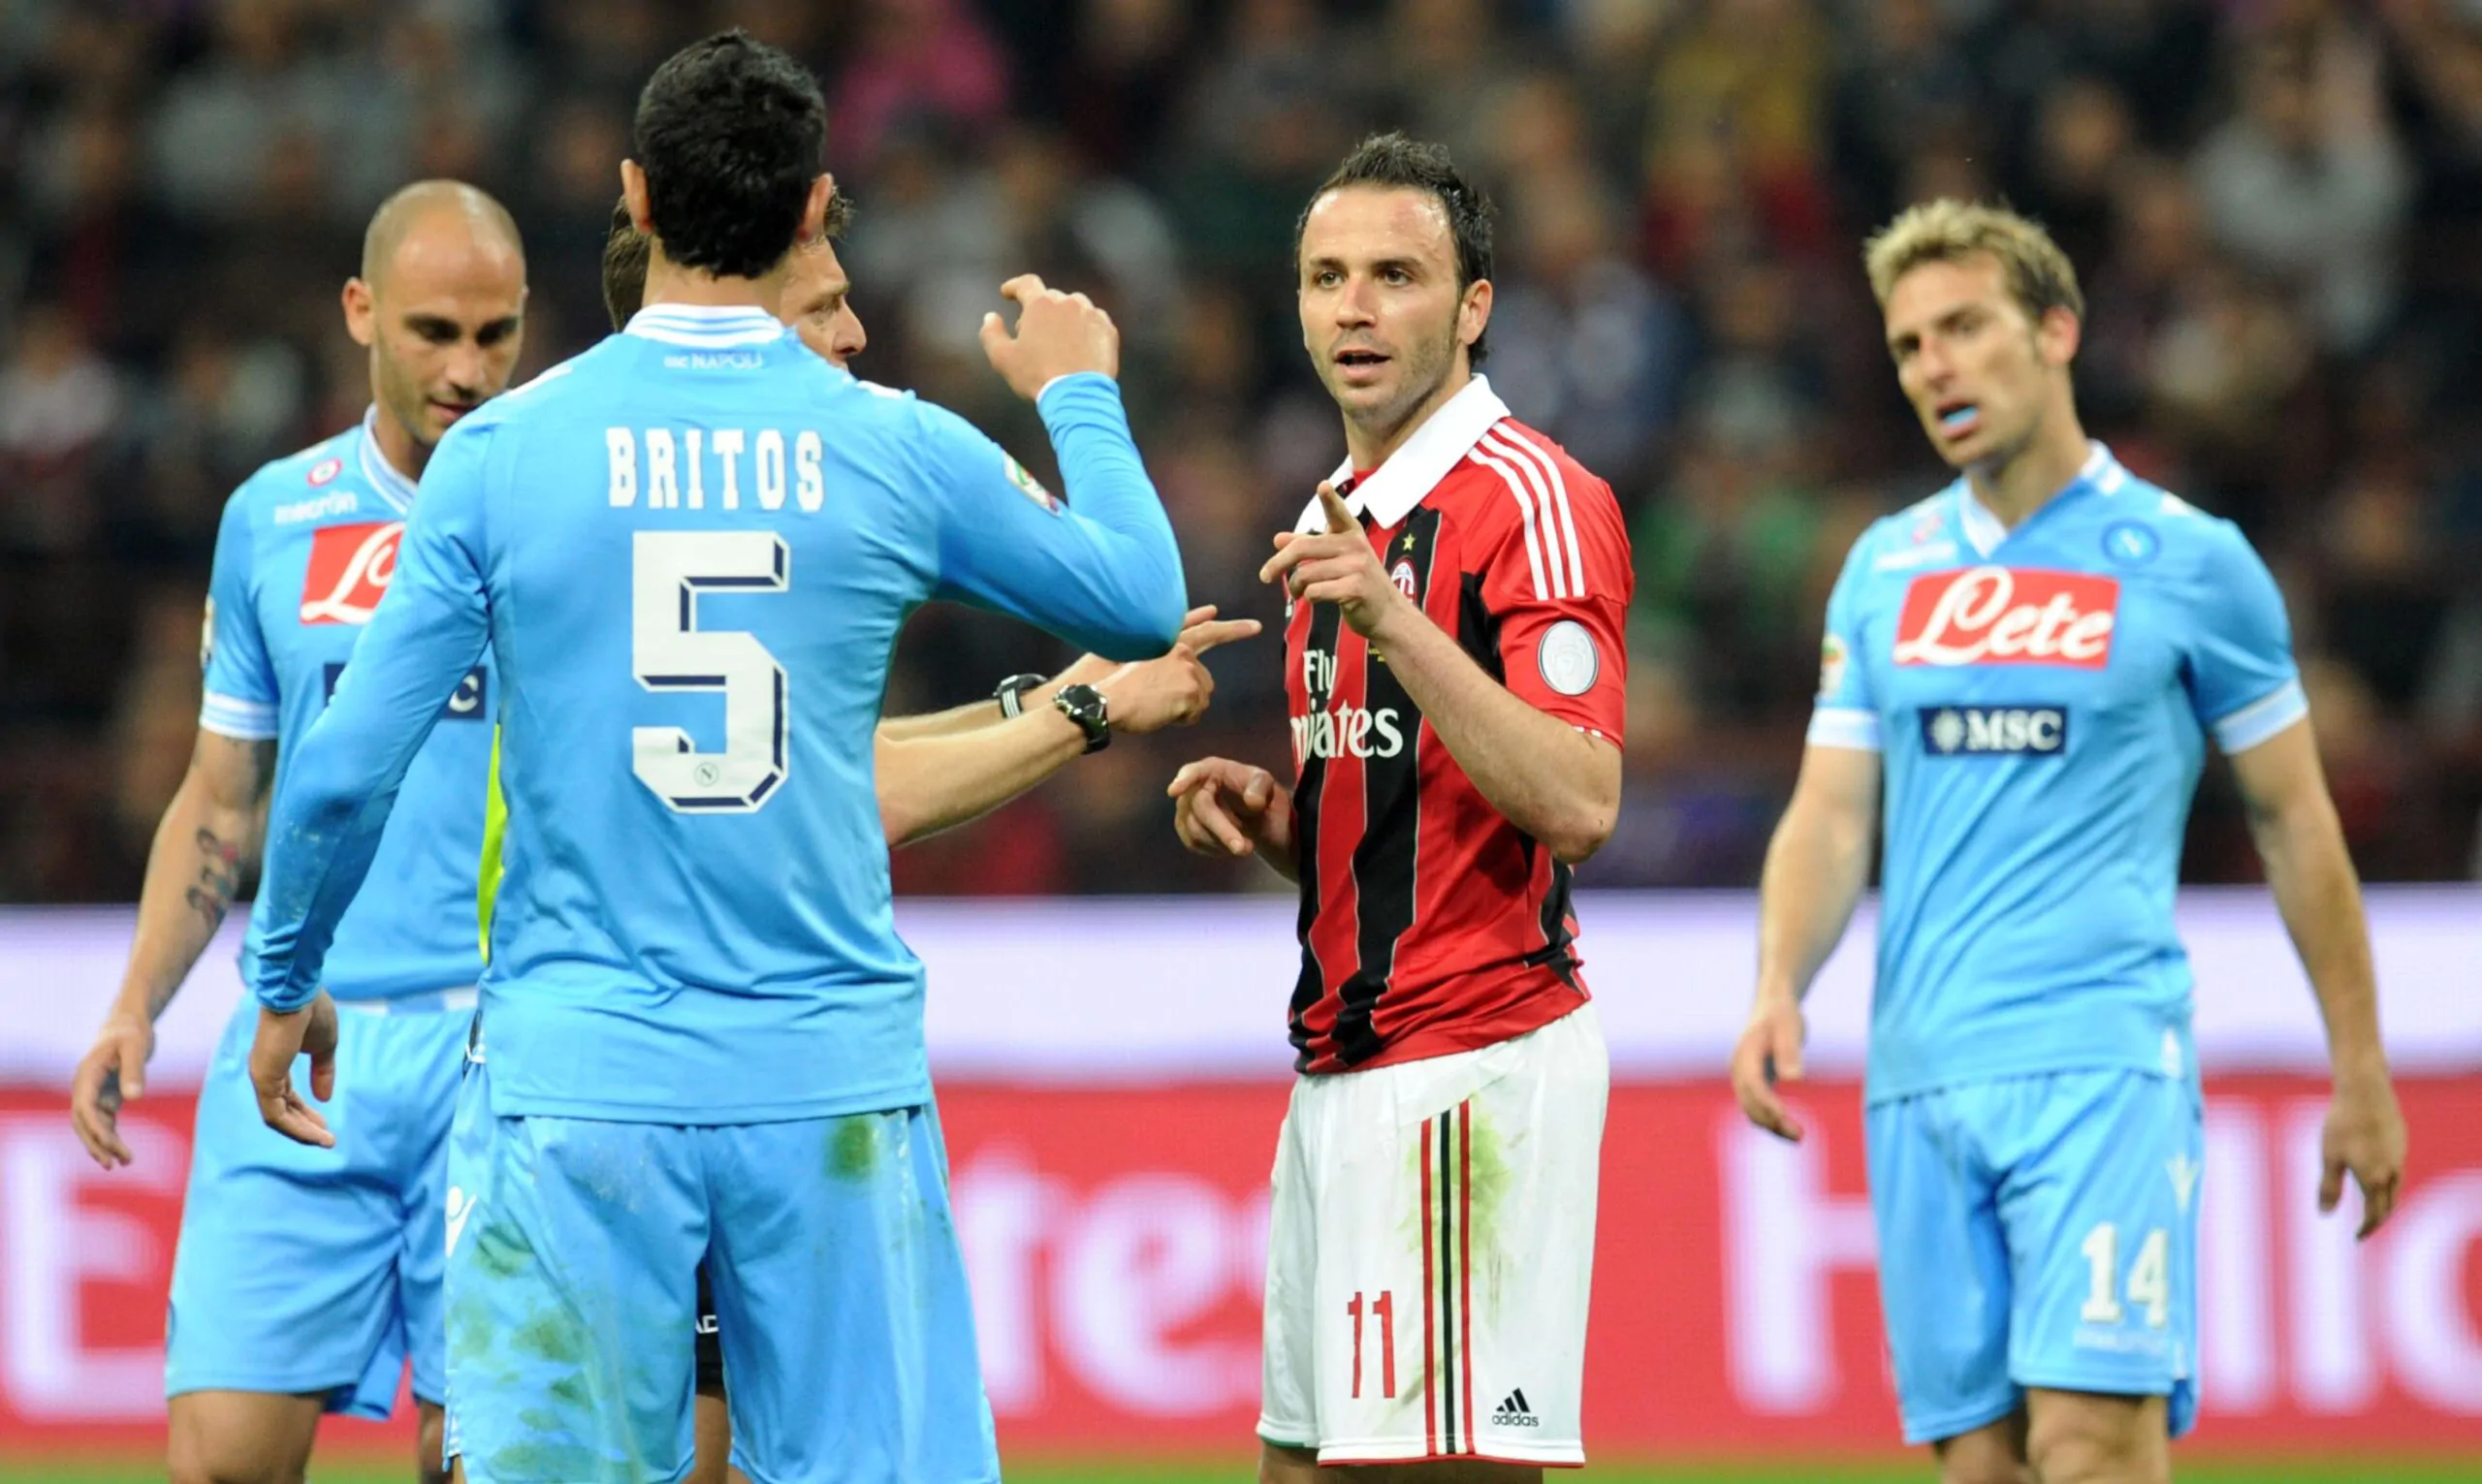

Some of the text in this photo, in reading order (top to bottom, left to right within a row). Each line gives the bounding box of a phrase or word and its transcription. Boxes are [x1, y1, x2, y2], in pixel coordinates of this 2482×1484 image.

[606, 426, 824, 513] BRITOS
[1893, 566, 2114, 666] Lete
[632, 530, 790, 814] 5
[1302, 648, 1338, 700] Fly
[1964, 709, 2063, 752] MSC
[2080, 1221, 2170, 1331] 14
[1348, 1290, 1396, 1399] 11
[1492, 1412, 1540, 1428] adidas
